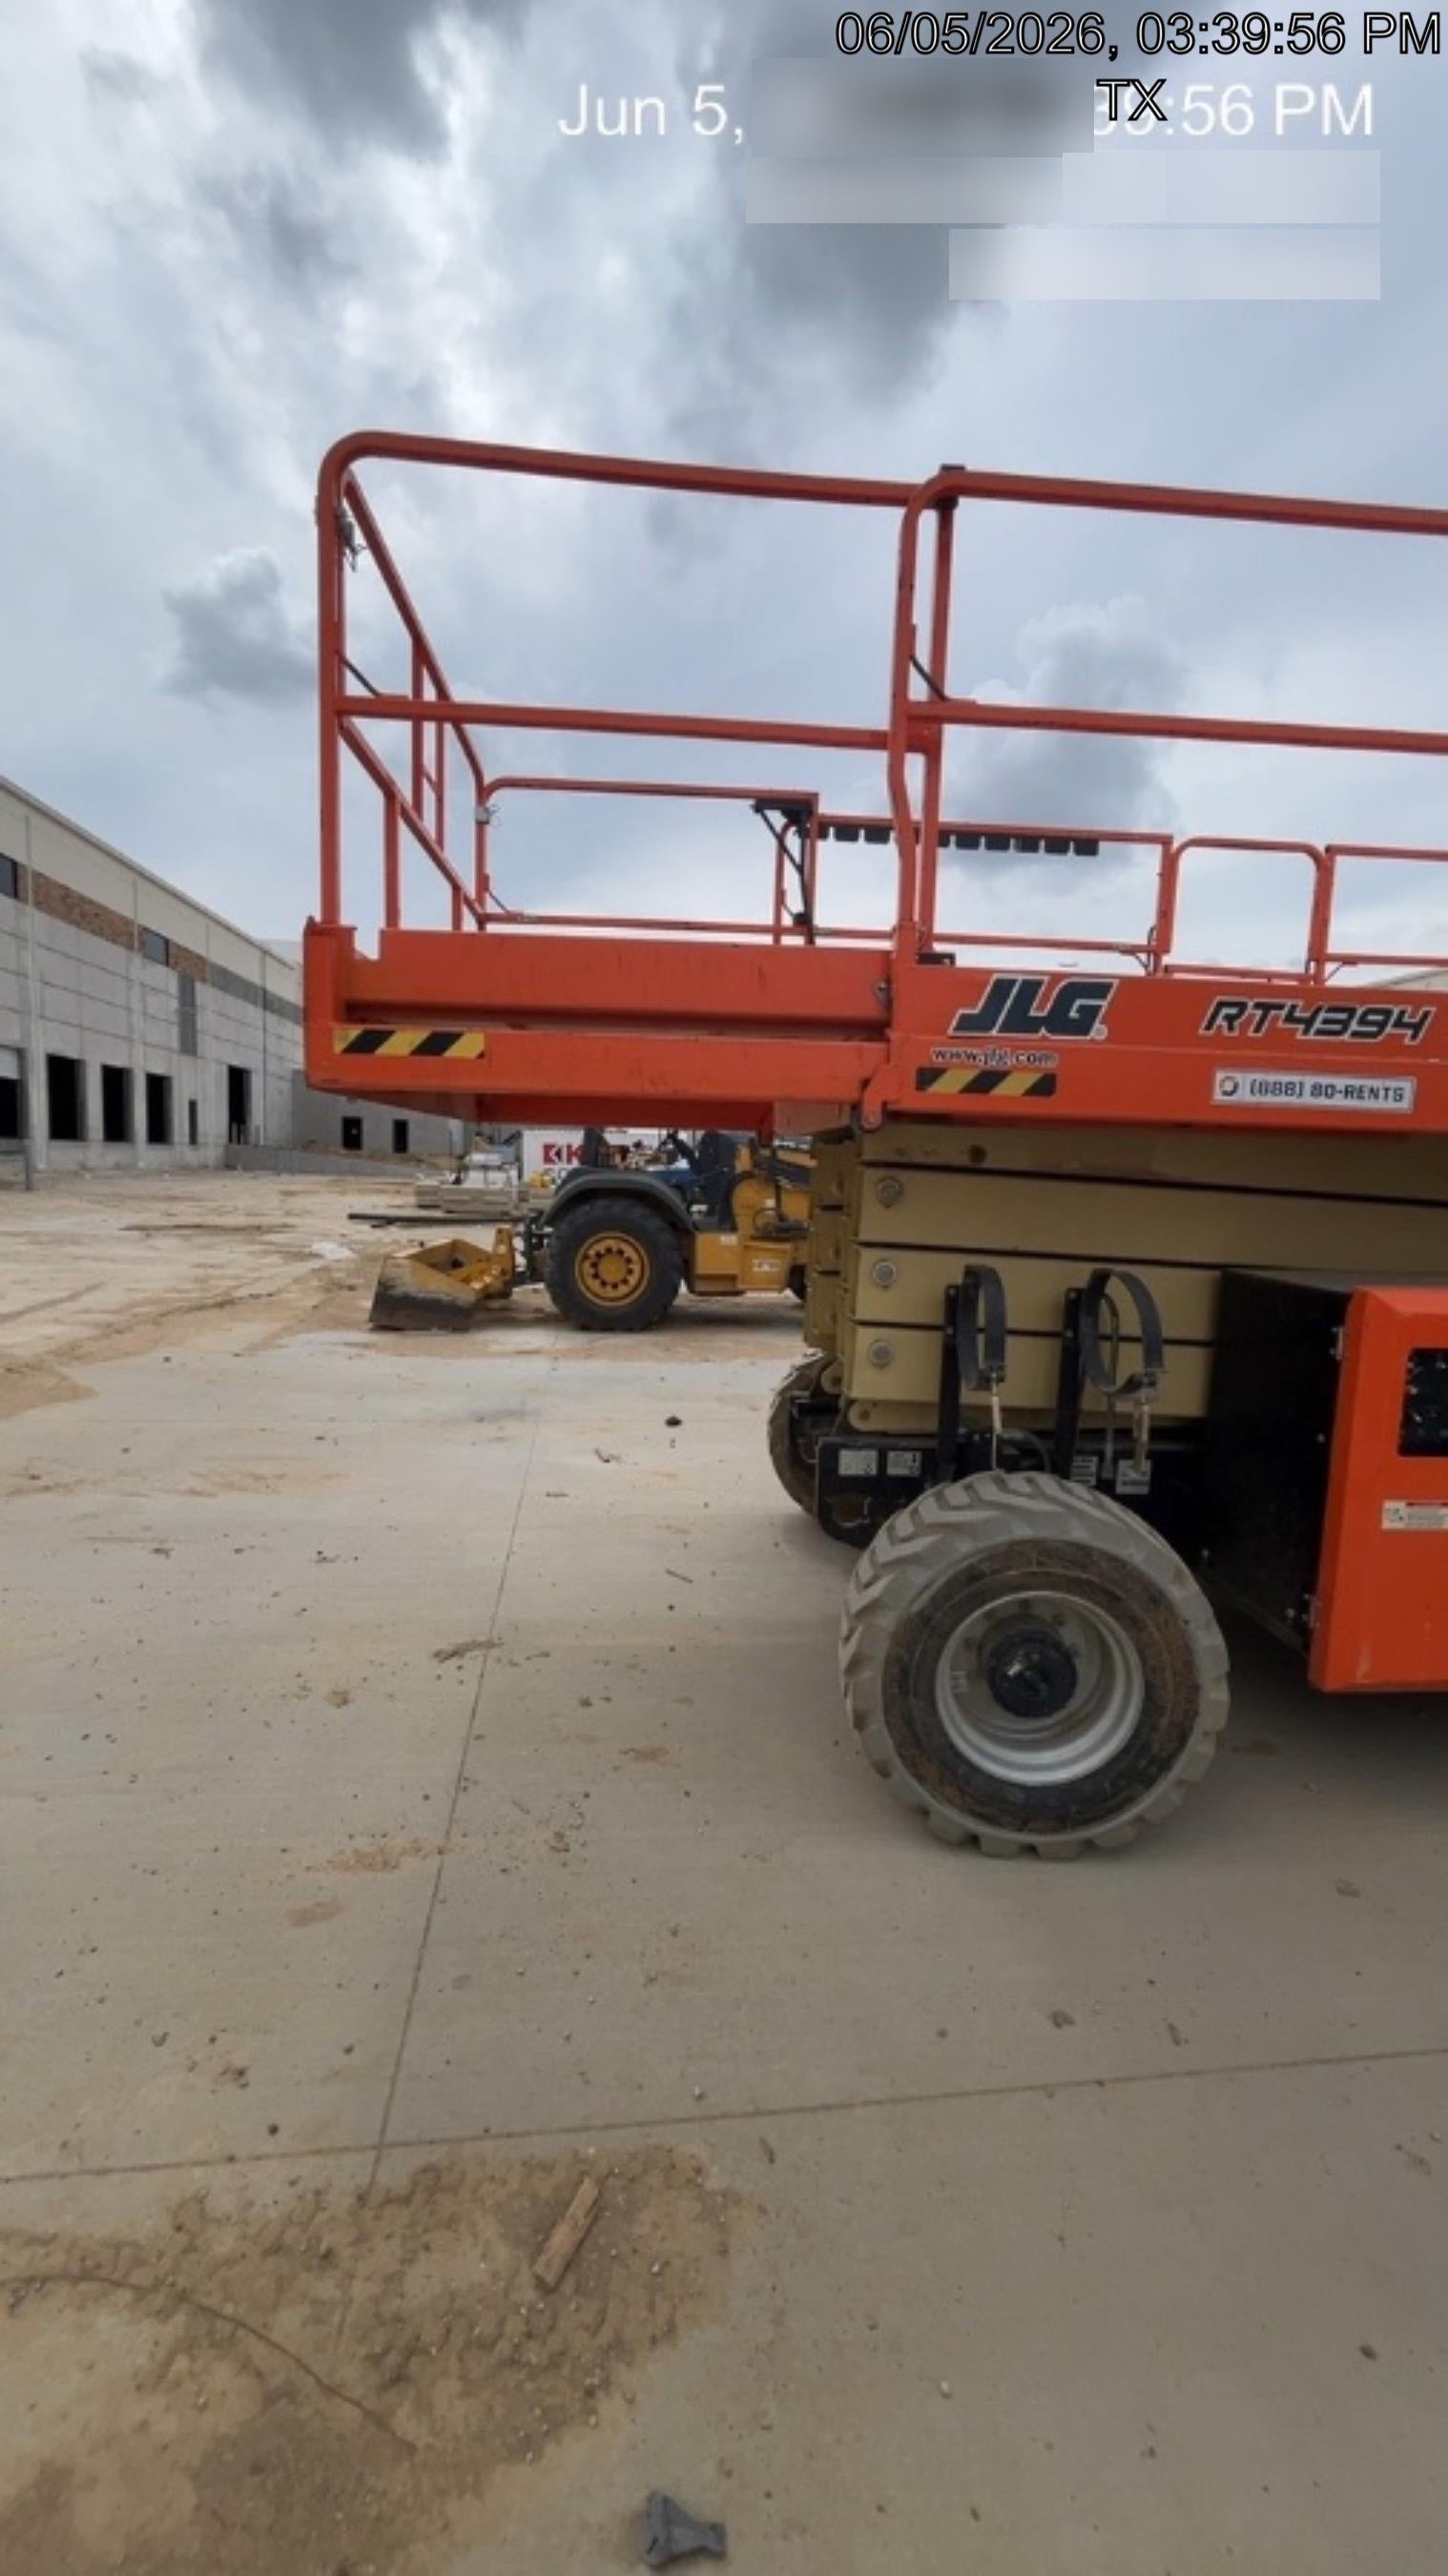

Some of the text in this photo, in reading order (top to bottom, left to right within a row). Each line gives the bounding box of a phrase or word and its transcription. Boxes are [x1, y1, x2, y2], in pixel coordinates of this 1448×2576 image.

[948, 973, 1120, 1041] JLG
[1199, 996, 1437, 1046] RT4394
[931, 1047, 1059, 1069] www.jlg.com
[1310, 1081, 1406, 1103] 80-RENTS
